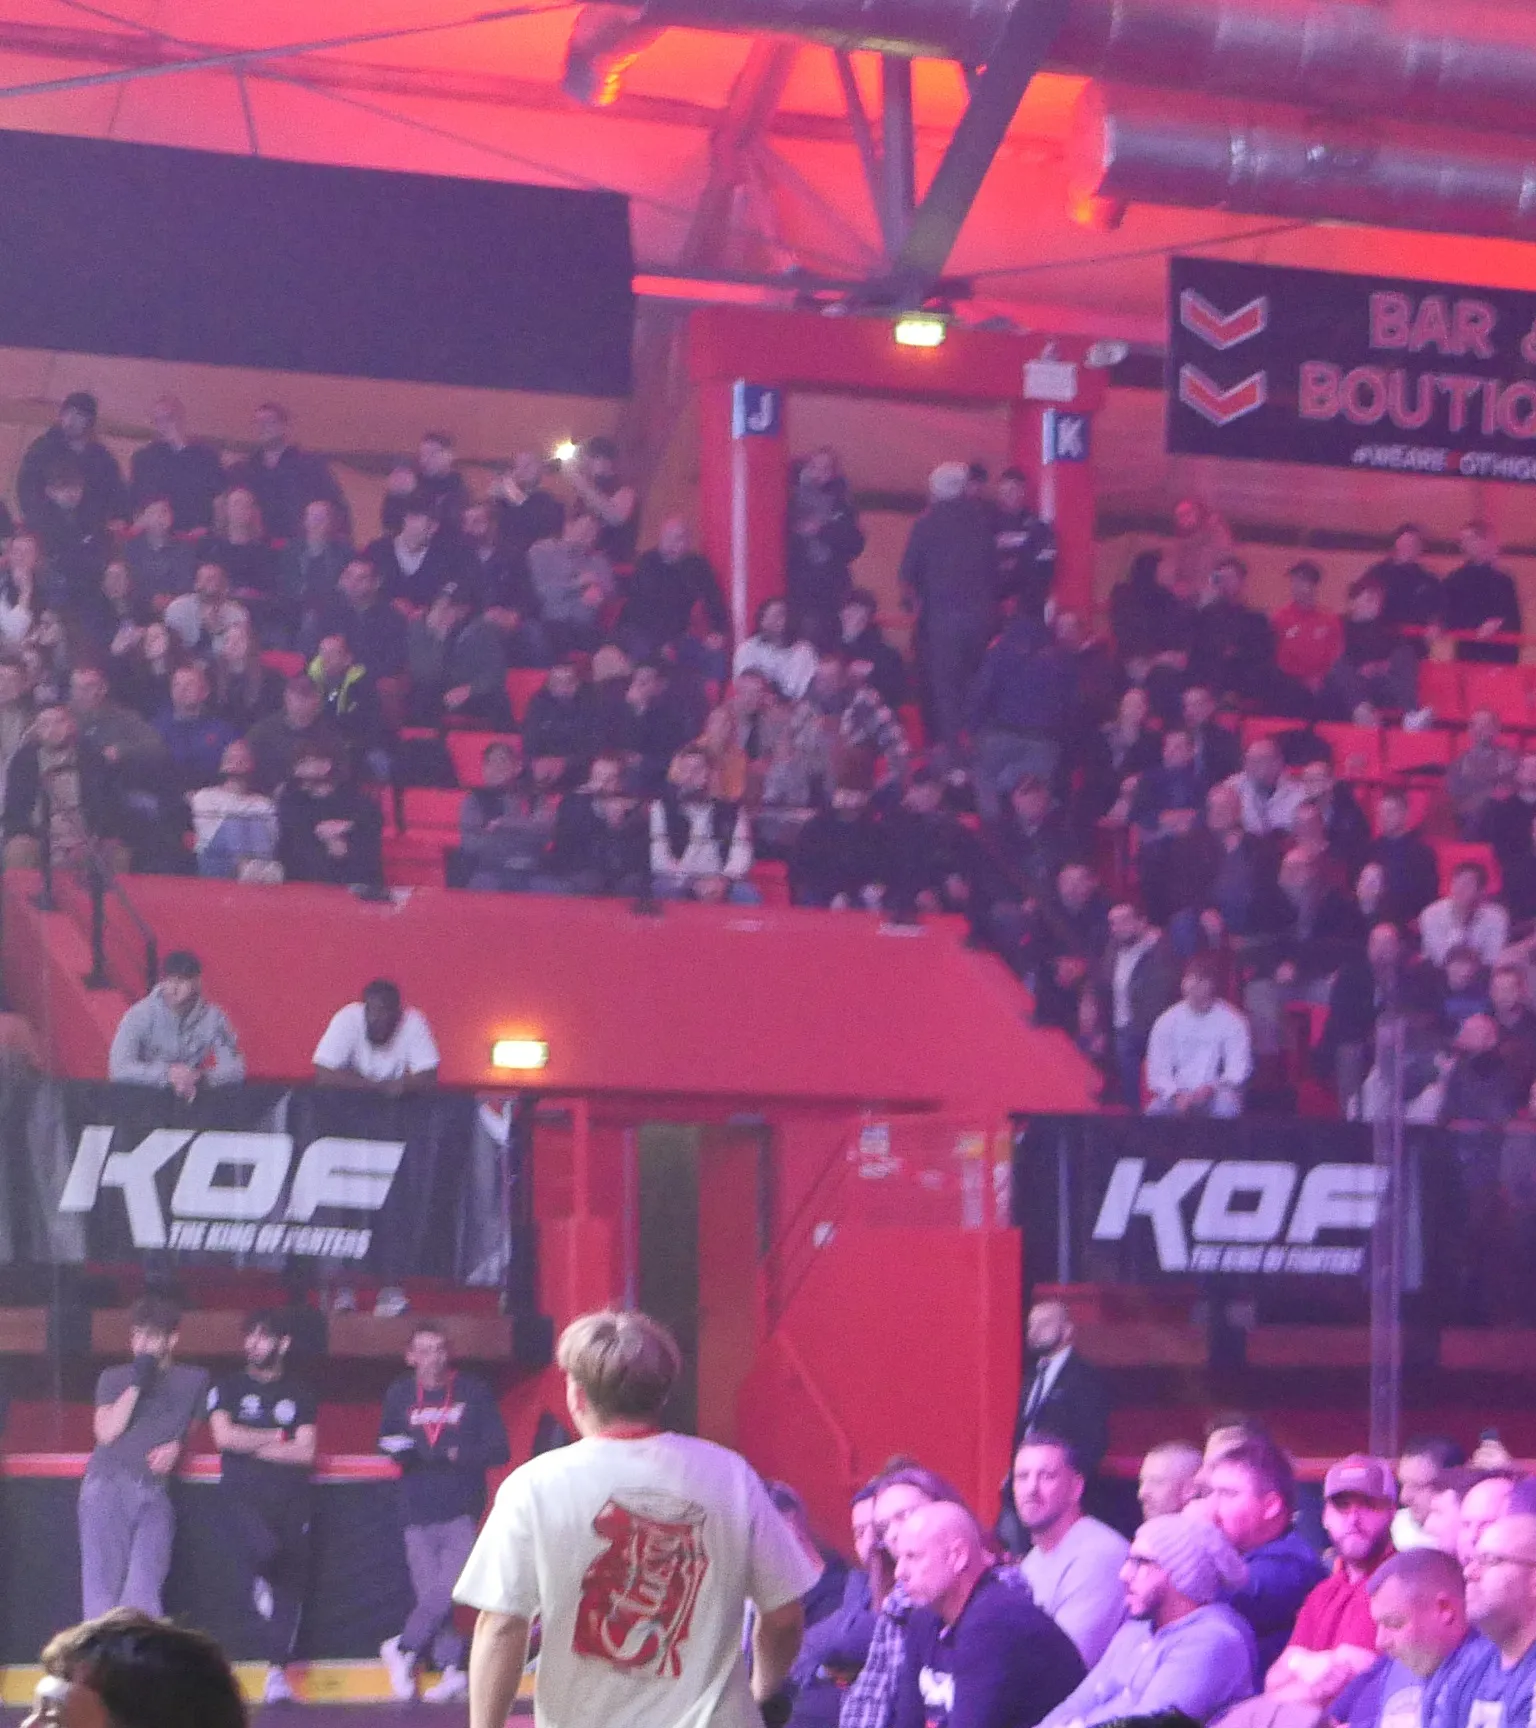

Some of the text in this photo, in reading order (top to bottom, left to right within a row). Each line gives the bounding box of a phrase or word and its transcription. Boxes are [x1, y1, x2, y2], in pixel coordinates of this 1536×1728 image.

[1368, 291, 1497, 359] BAR
[746, 390, 774, 432] J
[58, 1125, 407, 1249] KOF
[1091, 1157, 1391, 1273] KOF
